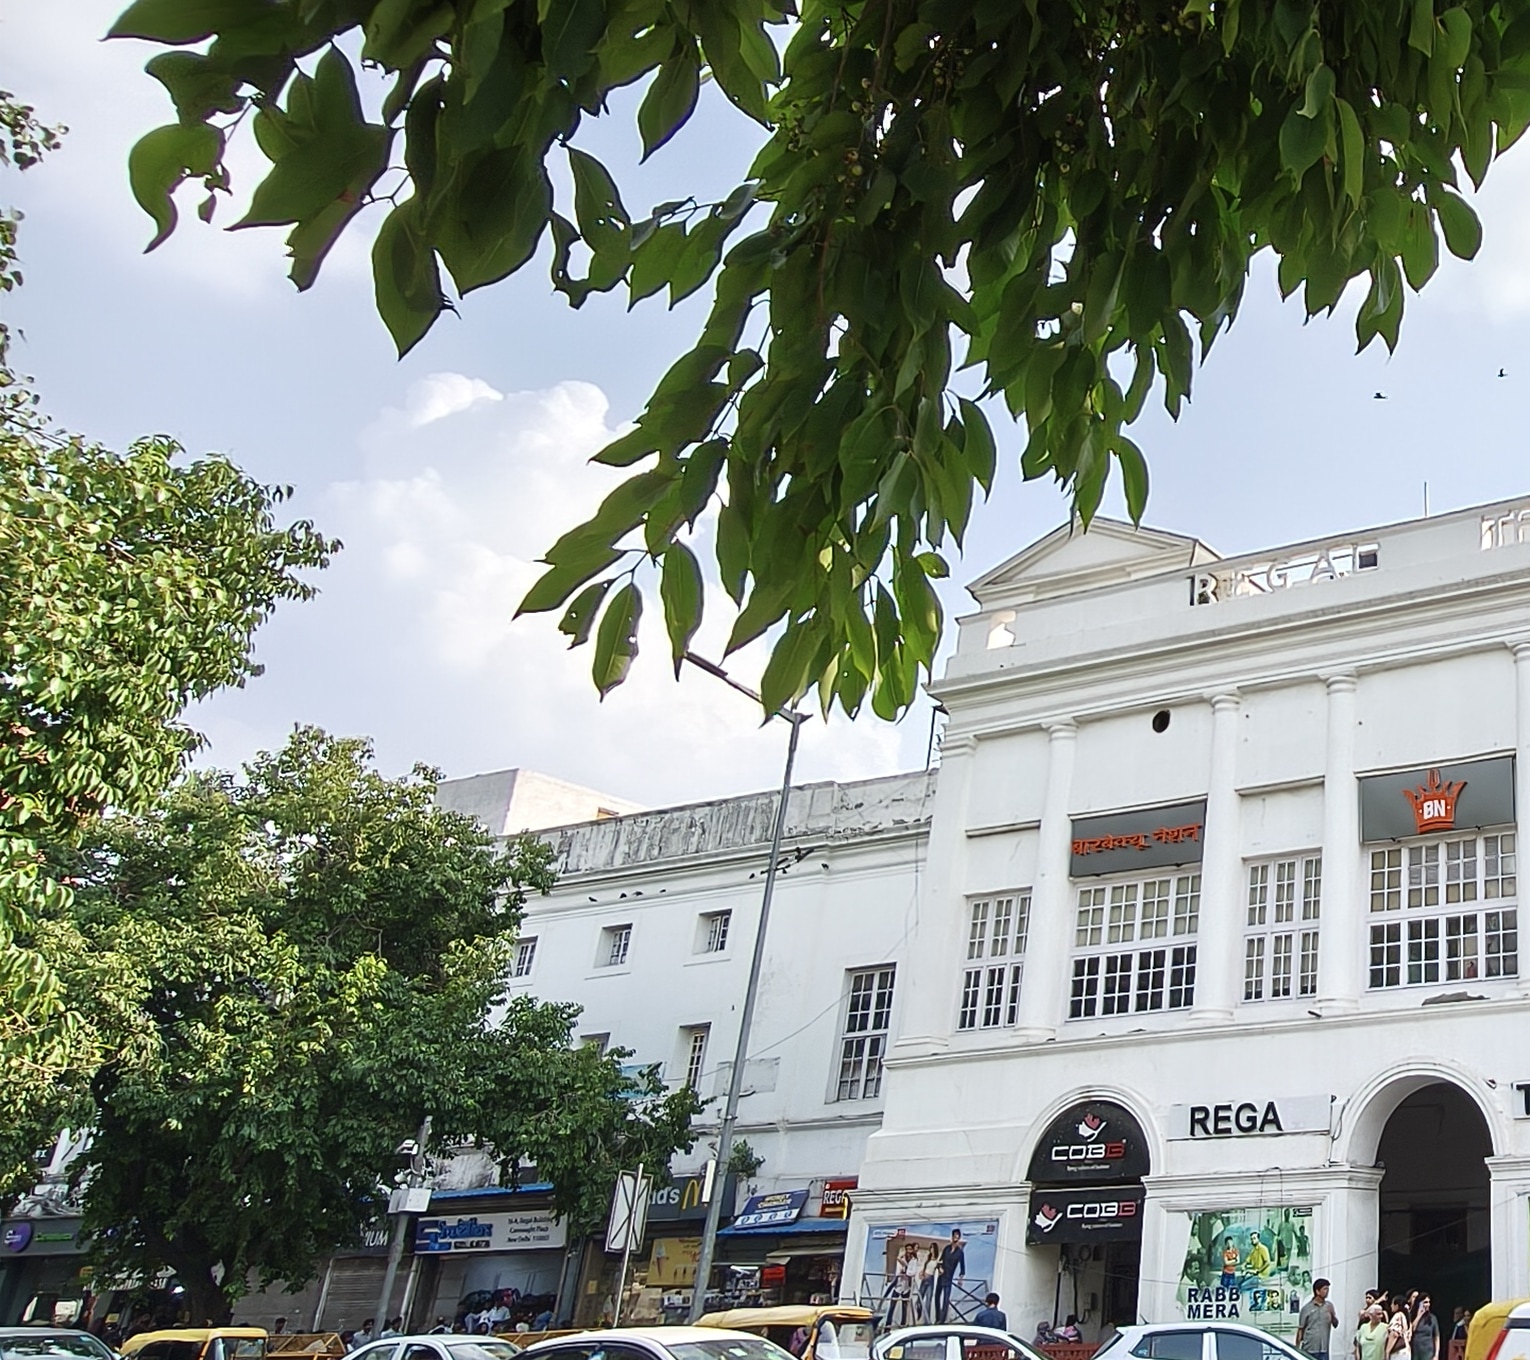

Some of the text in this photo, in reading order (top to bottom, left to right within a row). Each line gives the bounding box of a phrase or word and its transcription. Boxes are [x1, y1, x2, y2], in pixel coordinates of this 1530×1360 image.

[1423, 800, 1446, 819] BN
[1190, 1101, 1284, 1137] REGA
[1051, 1142, 1125, 1160] COBB
[1066, 1201, 1136, 1218] COBB
[1187, 1288, 1240, 1303] RABB
[1187, 1304, 1240, 1320] MERA
